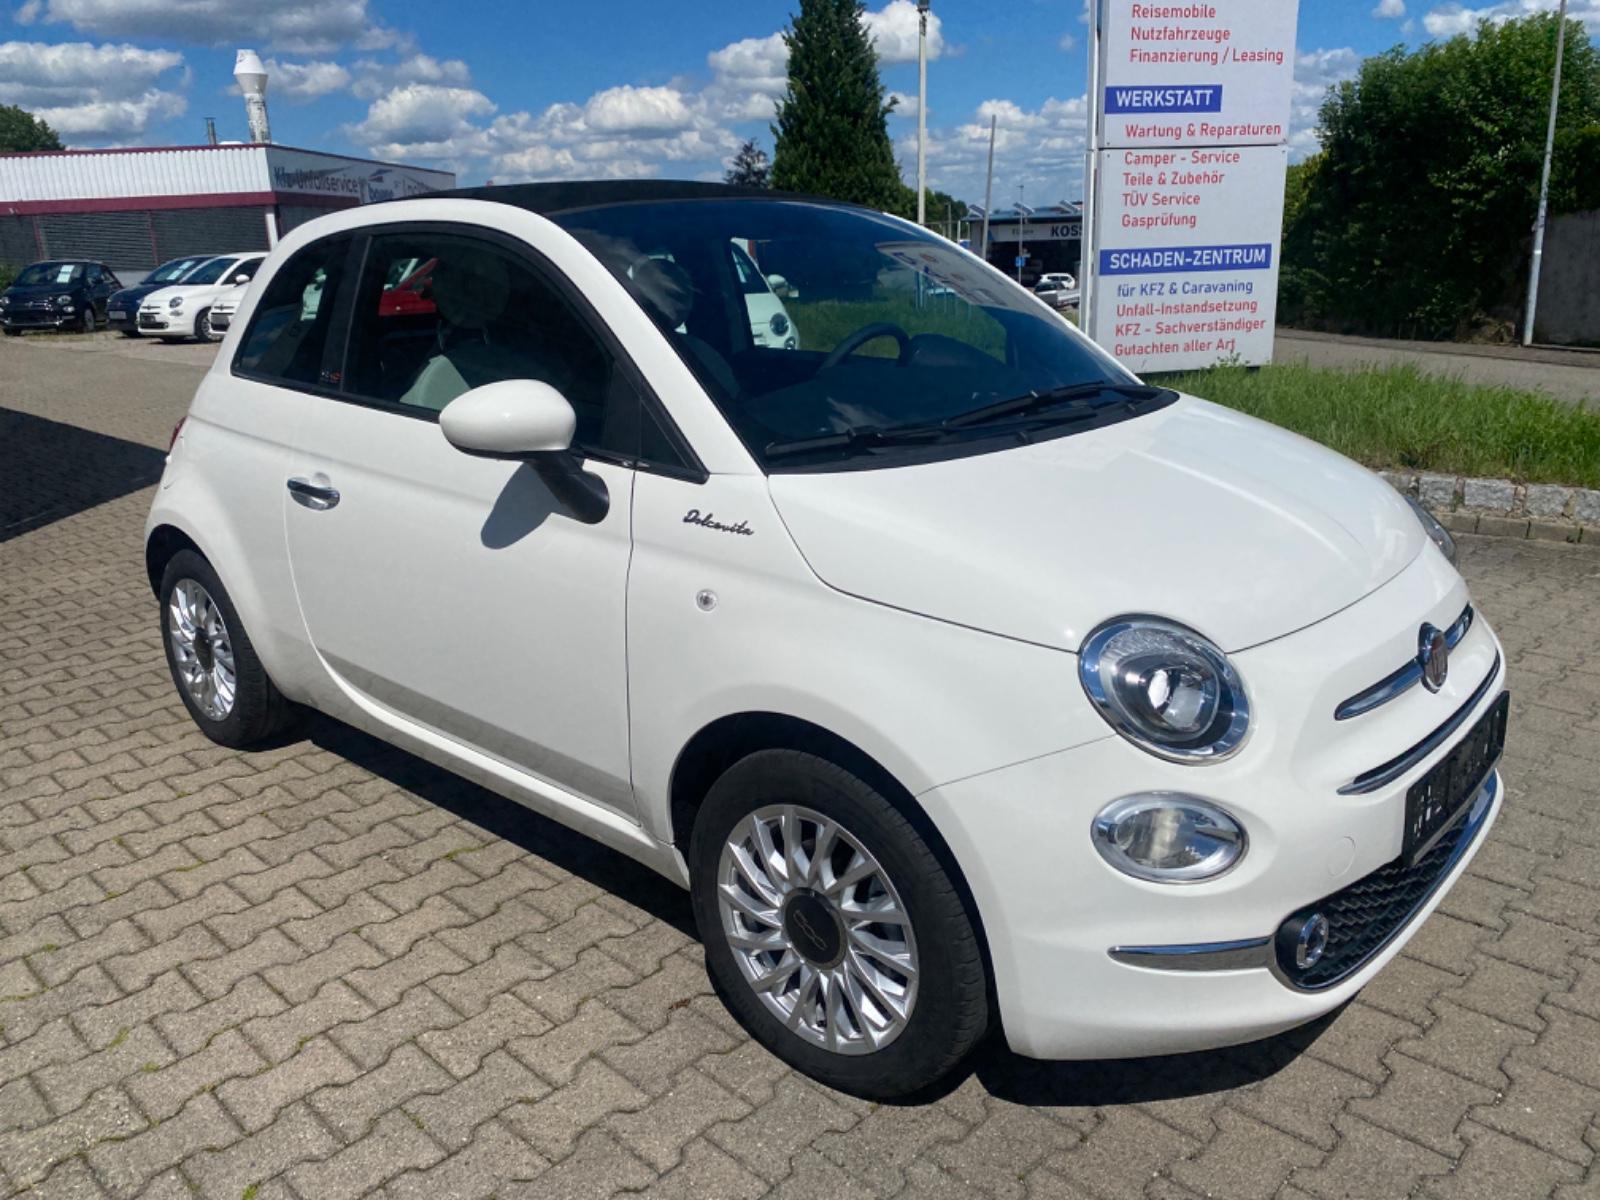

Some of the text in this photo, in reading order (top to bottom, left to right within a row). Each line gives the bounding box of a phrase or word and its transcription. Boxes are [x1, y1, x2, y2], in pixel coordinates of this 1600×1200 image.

[1131, 4, 1216, 19] Reisemobile
[1130, 26, 1231, 43] Nutzfahrzeuge
[1129, 48, 1219, 65] Finanzierung
[1232, 48, 1284, 65] Leasing
[1115, 89, 1214, 107] WERKSTATT
[1125, 122, 1281, 140] Wartung & Reparaturen
[1124, 151, 1176, 167] Camper
[1191, 150, 1240, 164] Service
[1123, 170, 1225, 186] Teile & Zubehör
[1122, 191, 1200, 206] TÜV Service
[1121, 212, 1197, 229] Gasprüfung
[1050, 225, 1082, 237] KOS
[1109, 248, 1266, 269] SCHADEN-ZENTRUM
[1117, 279, 1253, 297] für KFZ & Caravaning
[1116, 300, 1258, 317] Unfall-Instandsetzung
[1114, 323, 1141, 337] KFZ
[1155, 318, 1266, 335] Sachverständiger
[1114, 338, 1236, 356] Gutachten aller Art
[683, 509, 754, 535] Dolcevita
